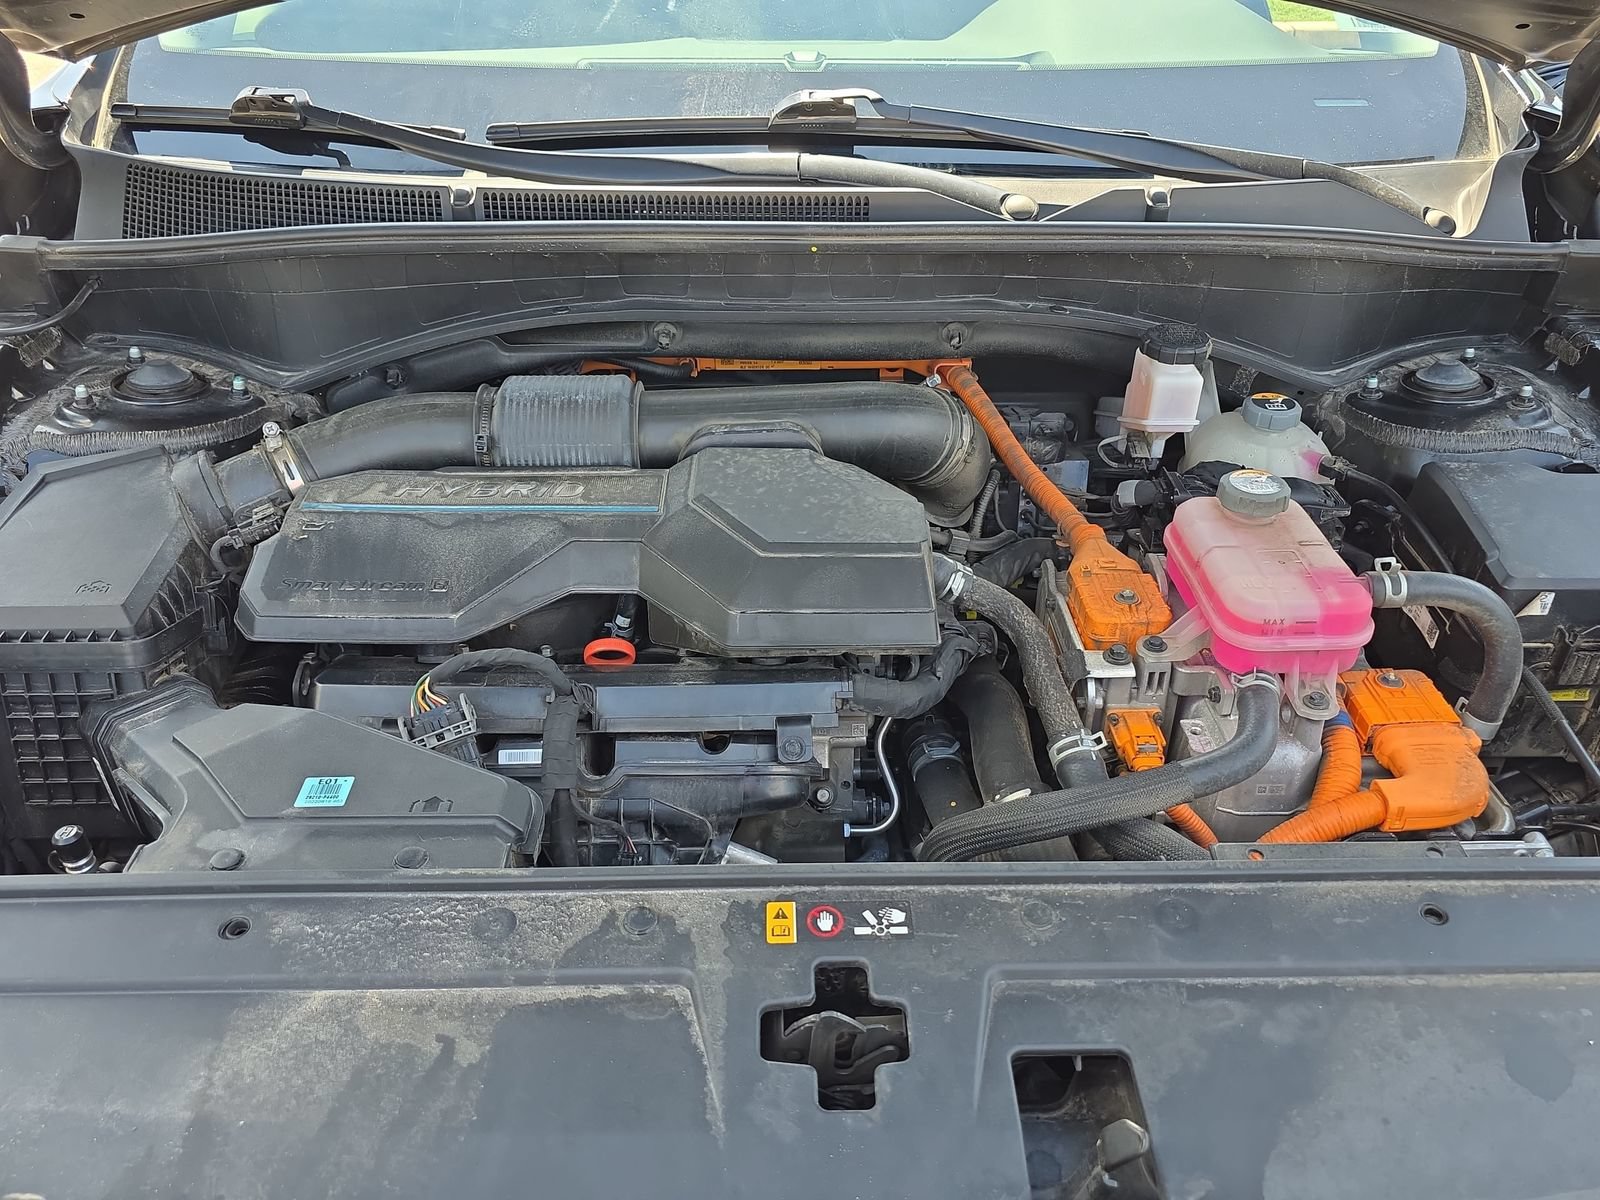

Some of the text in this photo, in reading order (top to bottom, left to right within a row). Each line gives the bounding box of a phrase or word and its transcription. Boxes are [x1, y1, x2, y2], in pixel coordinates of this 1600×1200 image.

[394, 481, 587, 498] HYBRID
[282, 578, 426, 591] Smartstream
[1260, 628, 1285, 636] MIN
